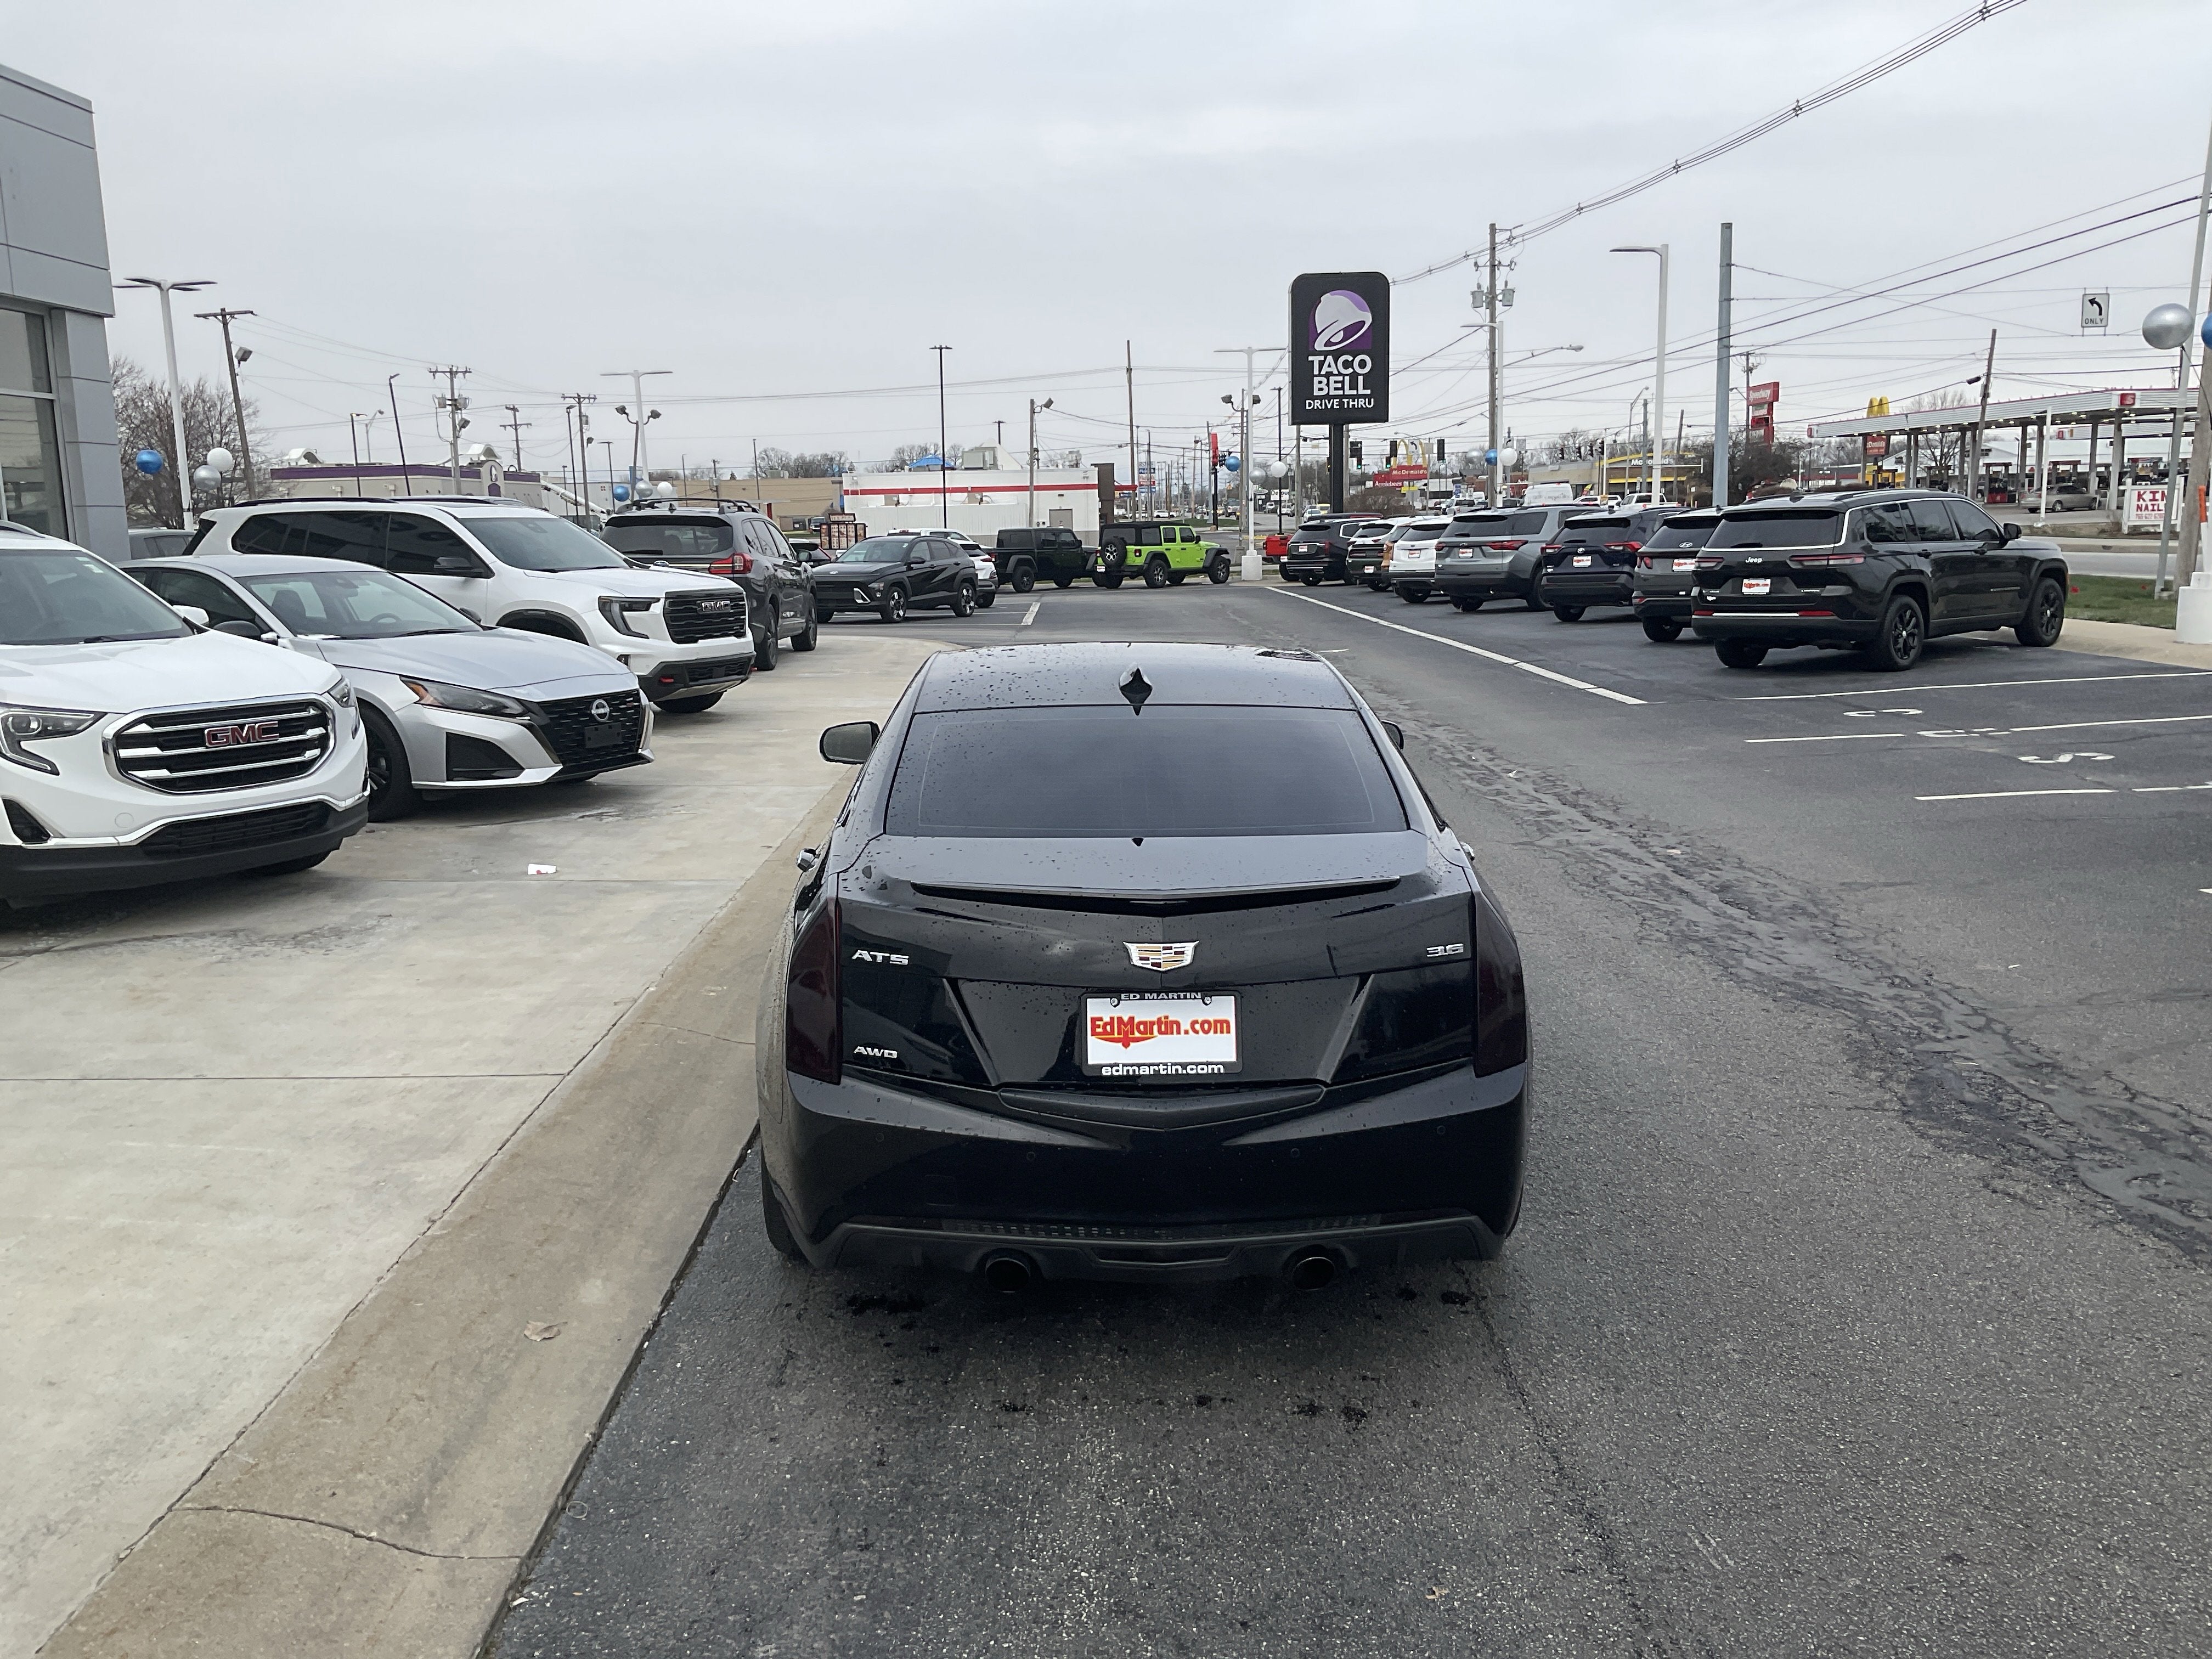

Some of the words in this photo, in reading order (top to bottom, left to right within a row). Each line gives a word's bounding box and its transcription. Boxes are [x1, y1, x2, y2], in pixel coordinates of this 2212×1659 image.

[1308, 354, 1372, 375] TACO
[1313, 376, 1371, 396] BELL
[1306, 399, 1340, 410] DRIVE
[1342, 398, 1374, 408] THRU
[2136, 504, 2164, 512] NAIL
[702, 601, 730, 612] GMC
[204, 721, 279, 747] GMC
[851, 950, 909, 966] ATS
[854, 1046, 898, 1059] AWD
[1102, 1062, 1224, 1075] edmartin.com
